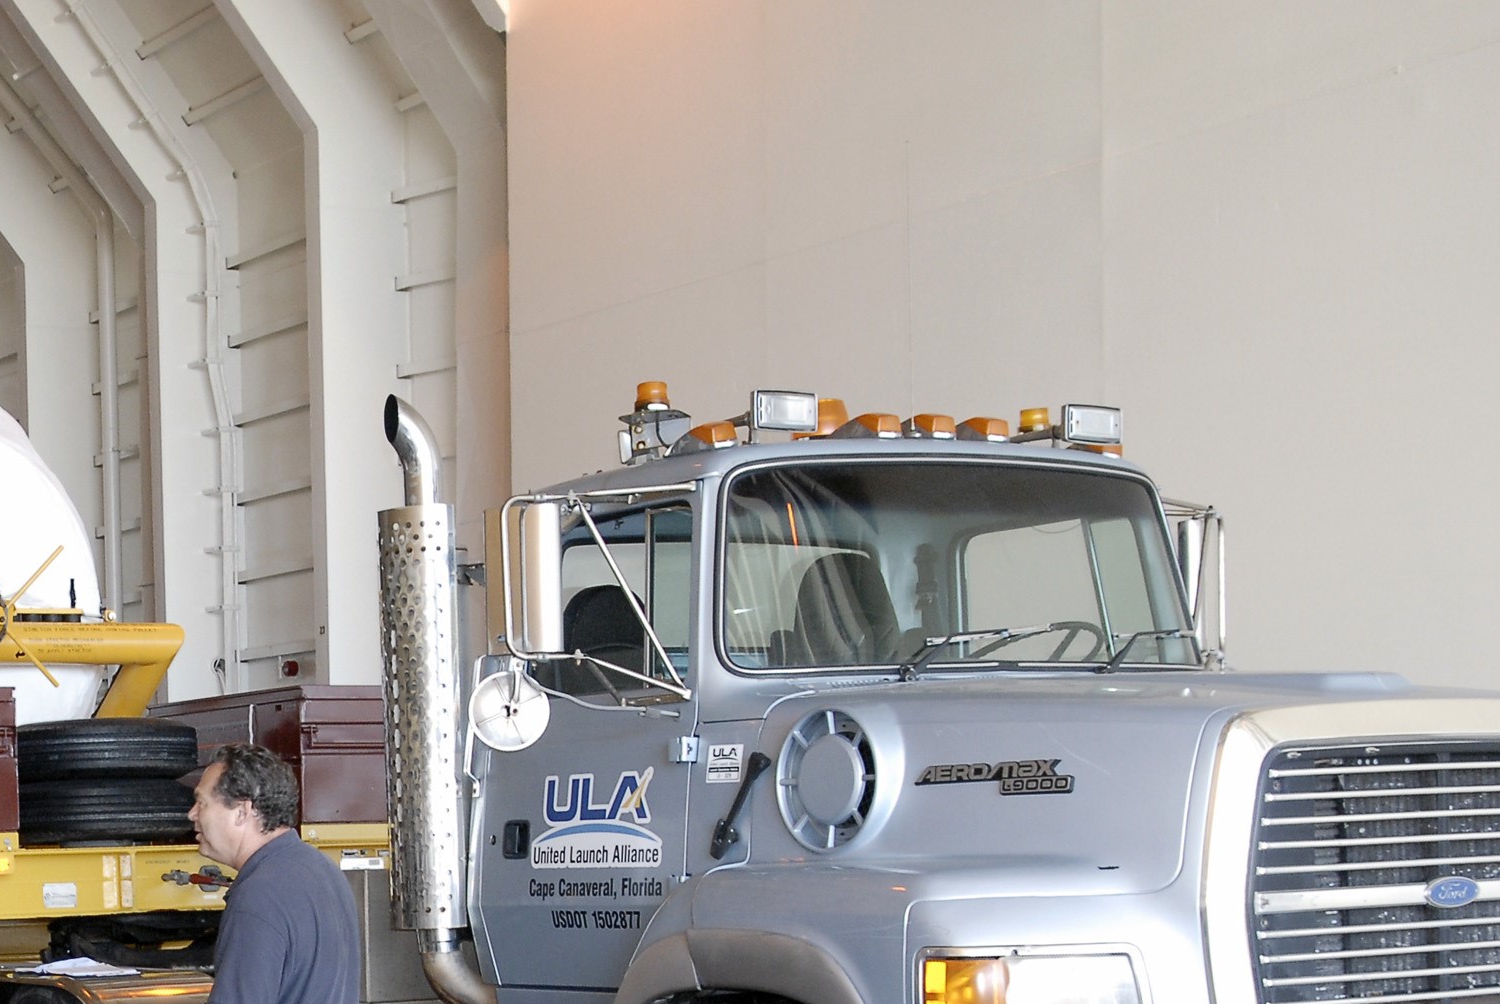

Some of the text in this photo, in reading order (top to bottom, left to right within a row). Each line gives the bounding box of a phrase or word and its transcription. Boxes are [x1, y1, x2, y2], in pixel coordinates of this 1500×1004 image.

[712, 747, 737, 757] ULA
[546, 775, 648, 822] ULA
[533, 845, 659, 864] United Launch Alliance
[529, 878, 662, 900] Cape Canaveral, Florida
[1438, 883, 1468, 900] Ford
[552, 911, 641, 929] USDOT 1502877
